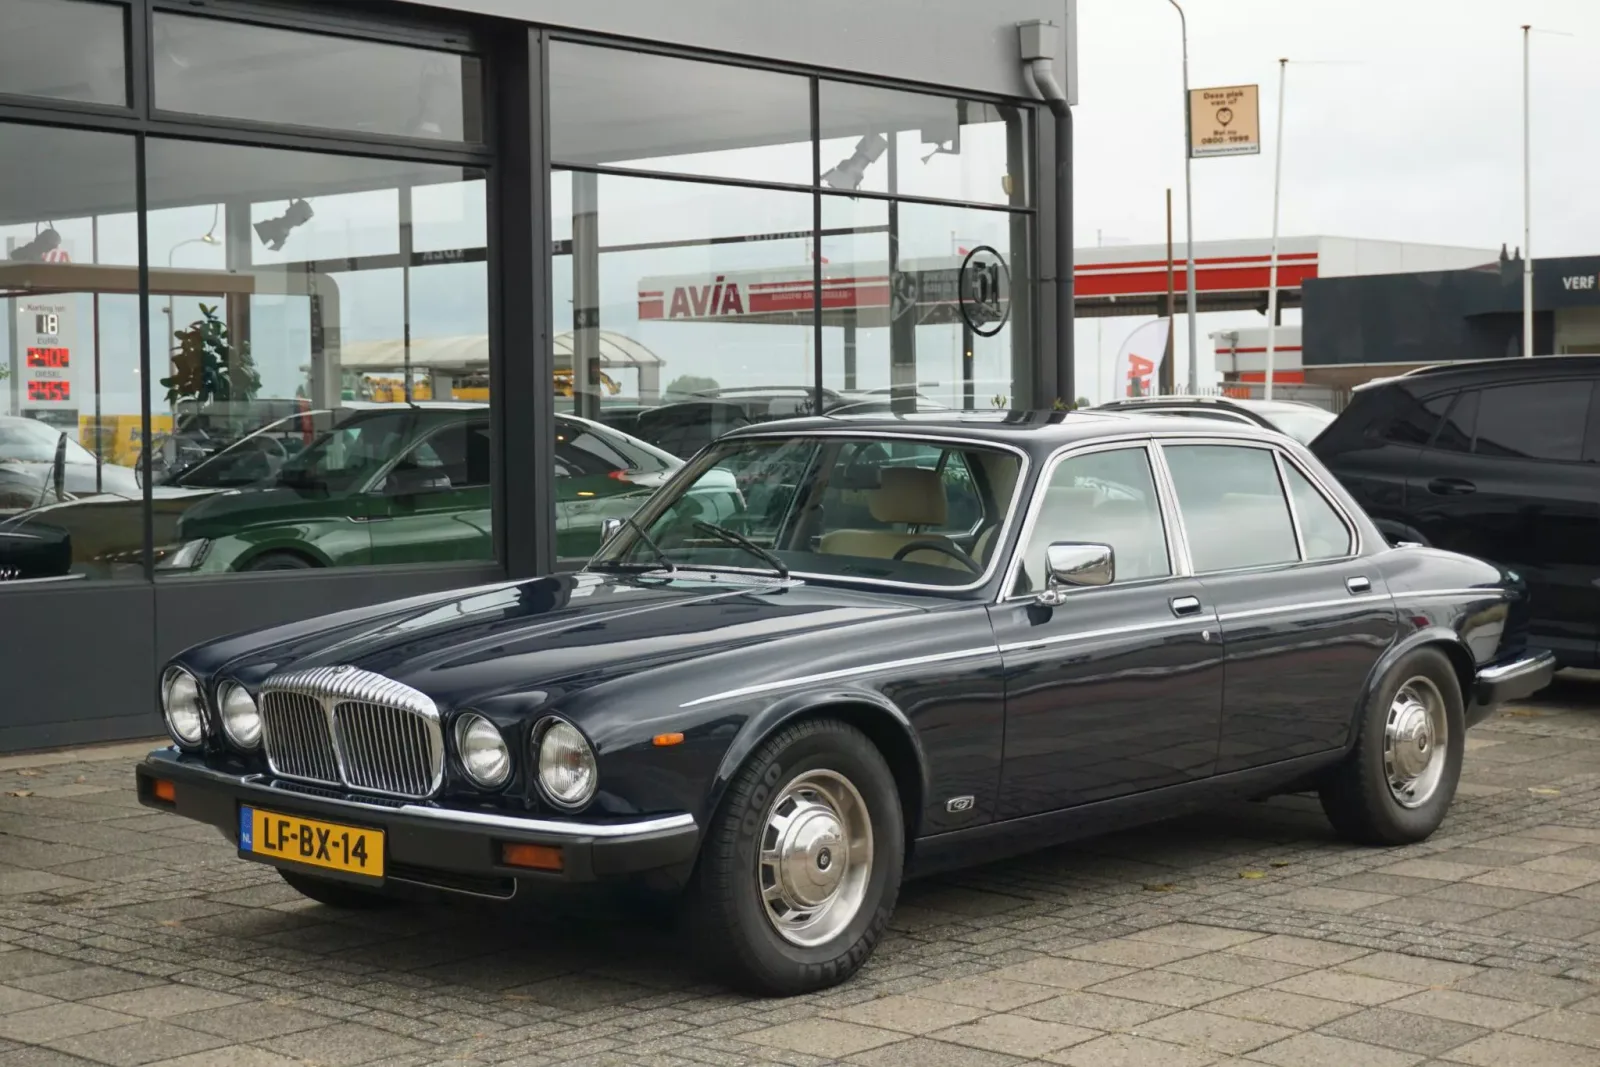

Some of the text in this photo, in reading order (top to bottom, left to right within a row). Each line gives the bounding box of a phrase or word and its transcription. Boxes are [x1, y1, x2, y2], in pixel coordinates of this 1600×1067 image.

[1562, 275, 1595, 290] VERF
[242, 817, 368, 867] NL LF-BX-14
